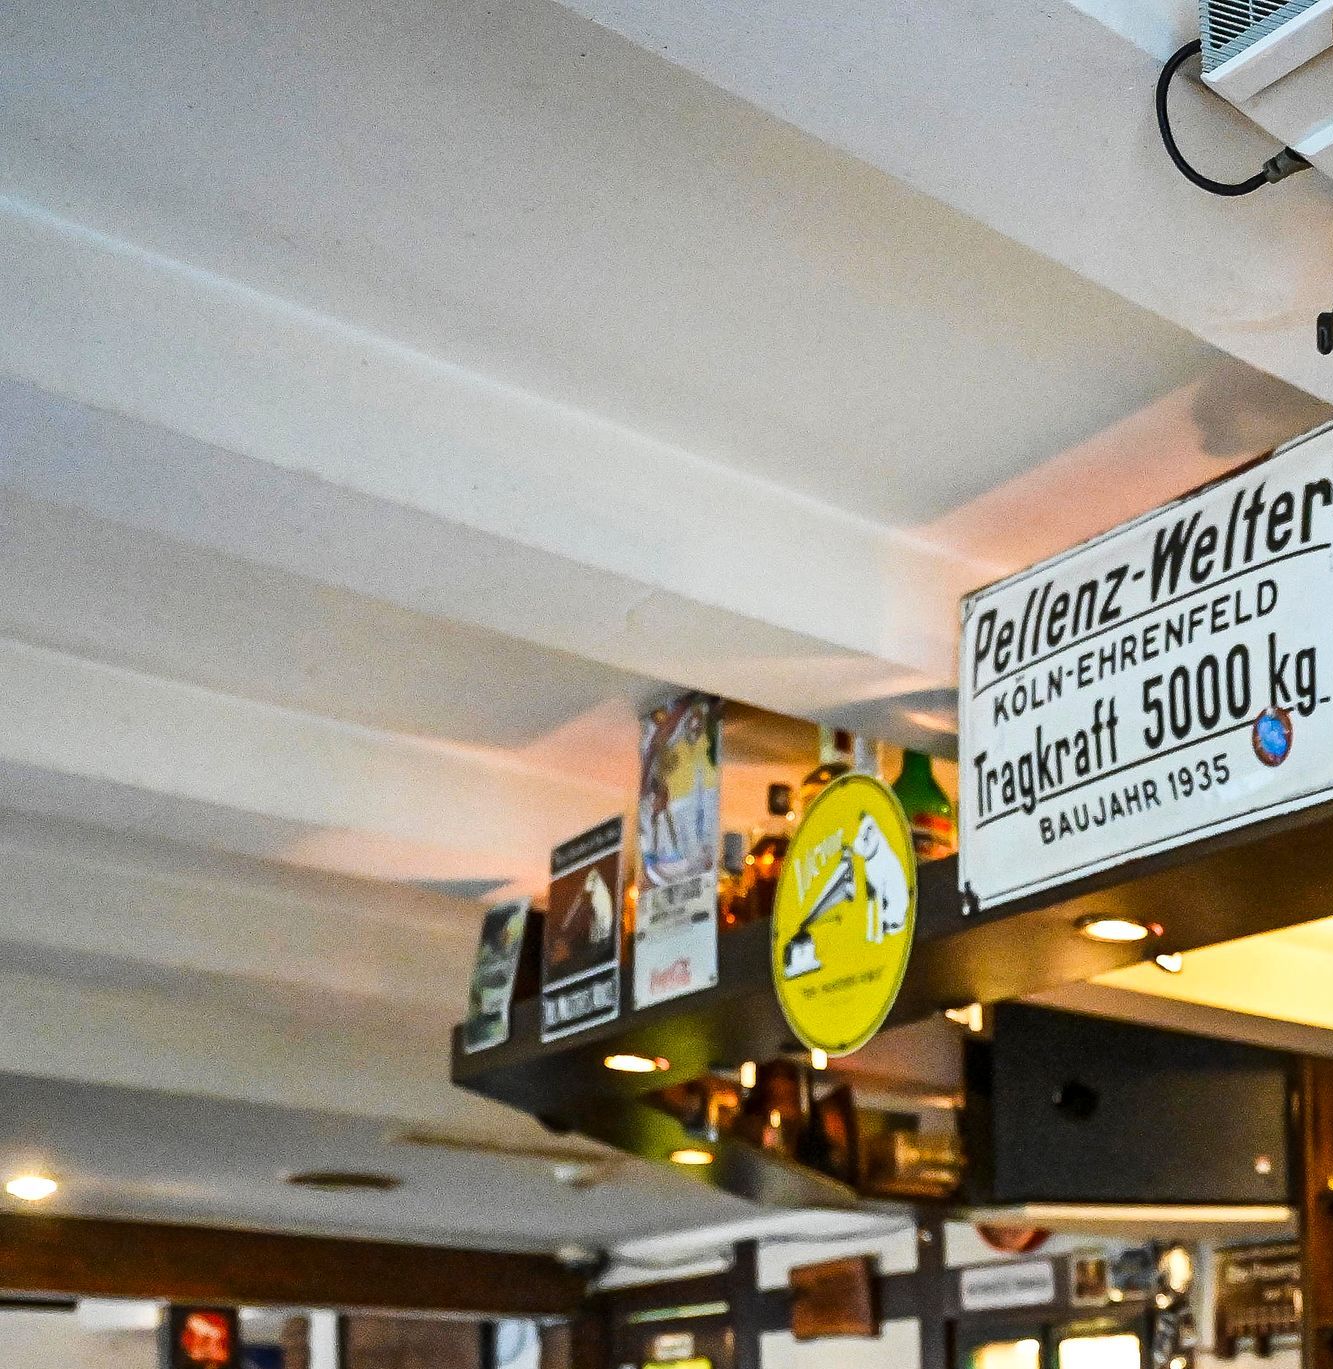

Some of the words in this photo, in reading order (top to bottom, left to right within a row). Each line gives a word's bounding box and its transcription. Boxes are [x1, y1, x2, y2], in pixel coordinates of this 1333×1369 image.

[973, 696, 1119, 817] Tragkraft
[1142, 643, 1252, 749] 5000
[1268, 632, 1316, 717] kg
[993, 579, 1278, 727] KÖLN-EHRENFELD
[1039, 779, 1162, 846] BAUJAHR
[1168, 752, 1231, 801] 1935
